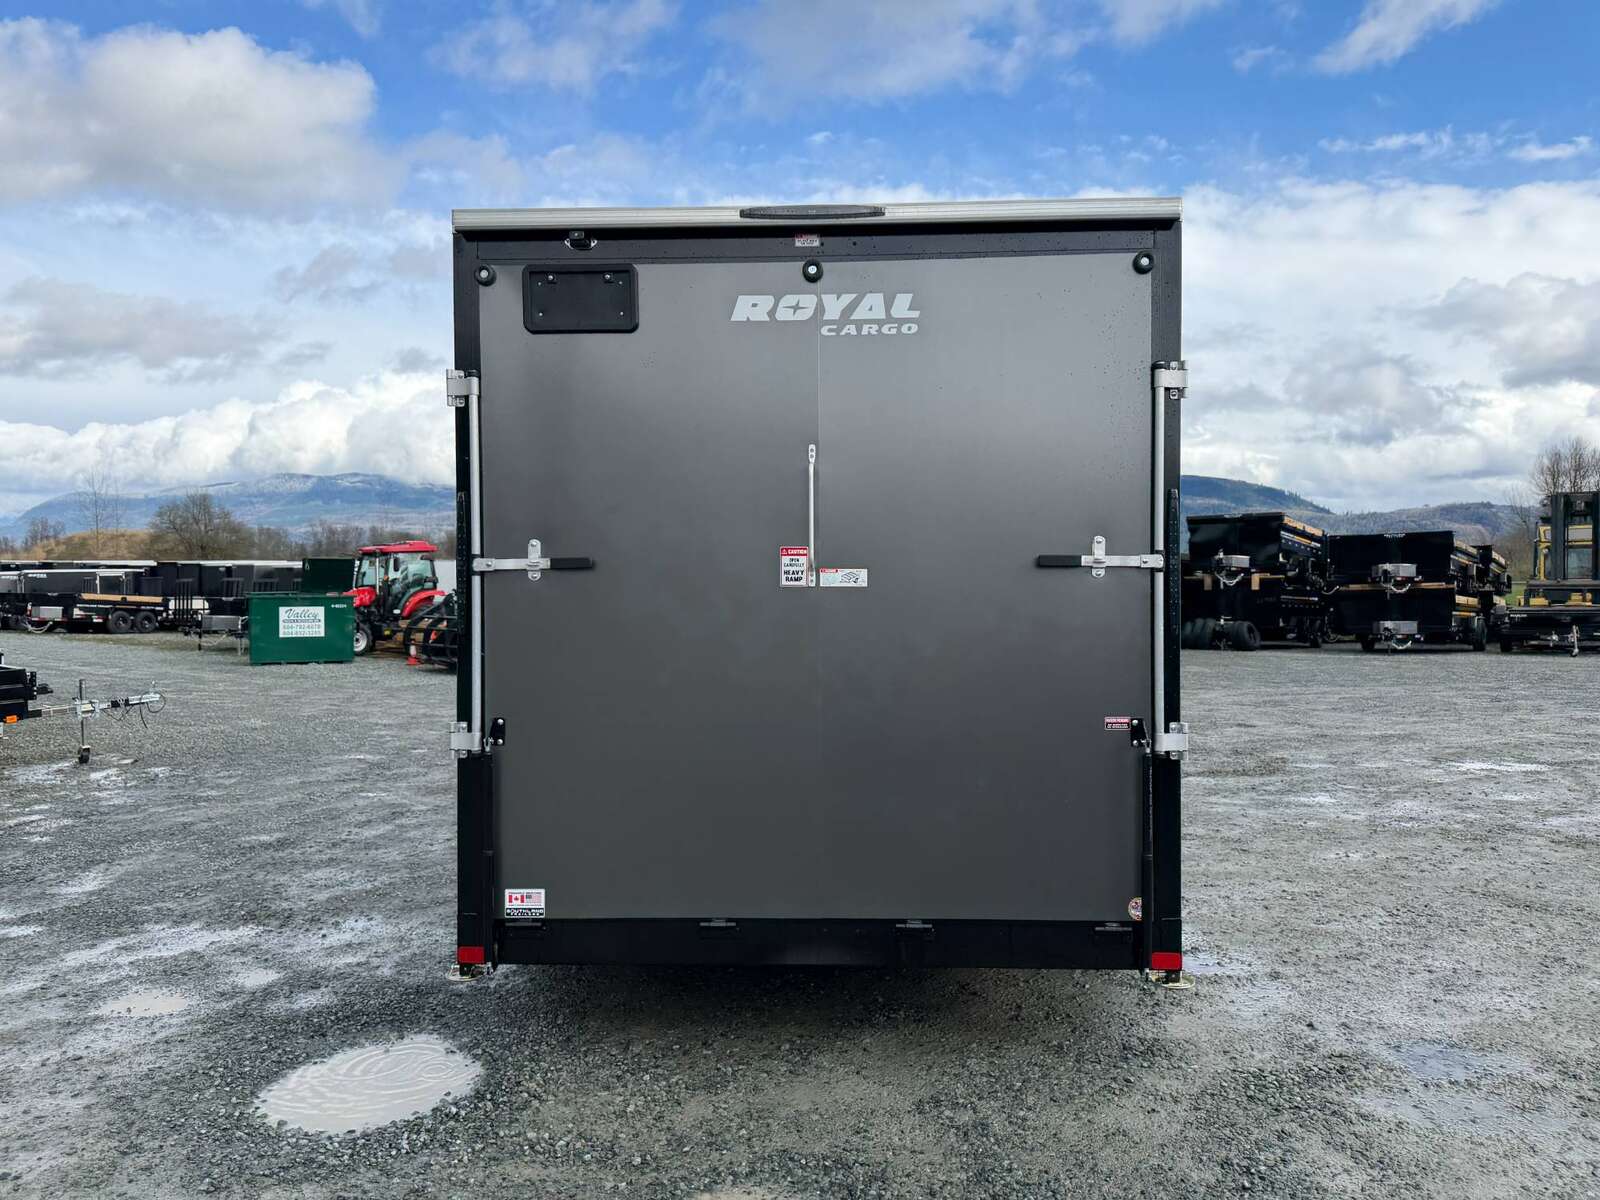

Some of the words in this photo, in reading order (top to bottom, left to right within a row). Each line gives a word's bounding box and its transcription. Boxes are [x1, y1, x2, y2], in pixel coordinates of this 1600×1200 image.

[730, 293, 920, 321] ROYAL
[820, 323, 919, 336] CARGO
[285, 608, 320, 619] Valley
